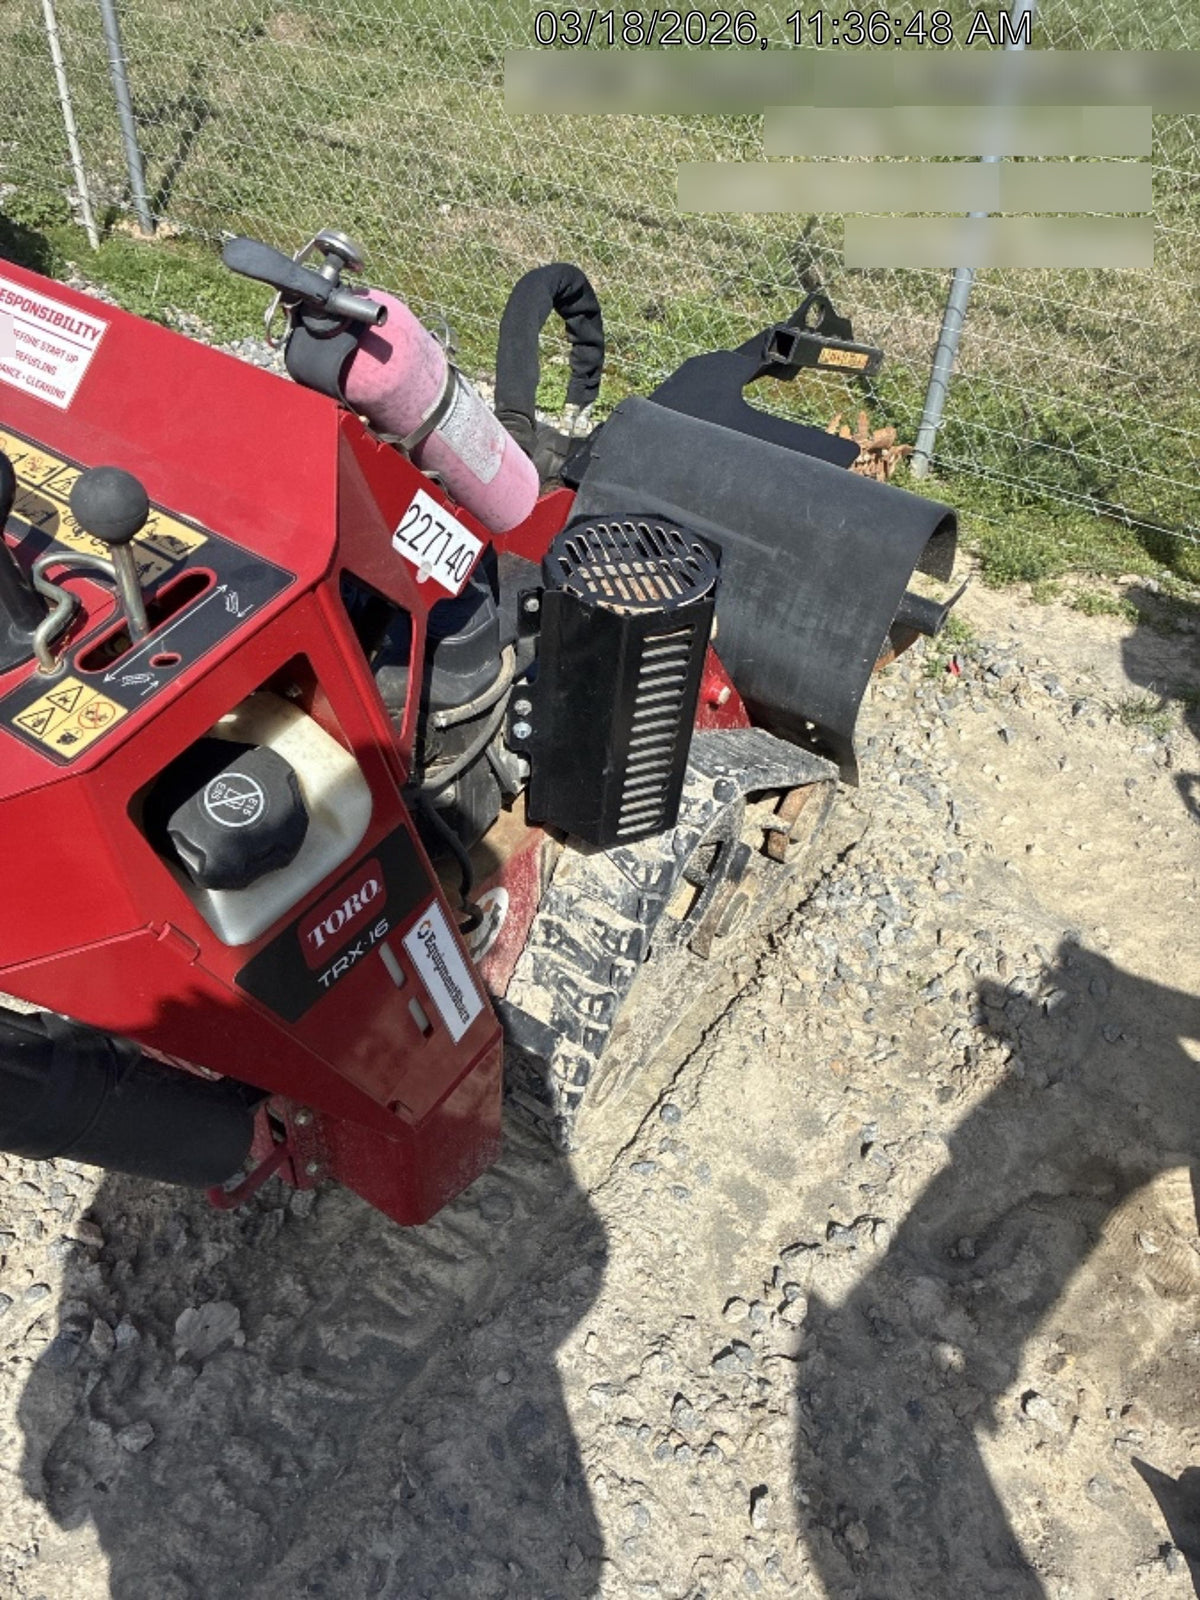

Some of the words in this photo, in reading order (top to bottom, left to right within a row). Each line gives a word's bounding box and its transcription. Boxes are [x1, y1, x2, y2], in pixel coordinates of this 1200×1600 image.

[0, 287, 101, 341] ESPONSIBILITY
[0, 363, 23, 379] ANCE
[395, 503, 475, 583] 227140
[307, 879, 379, 950] TORO
[317, 918, 390, 988] TRX-16
